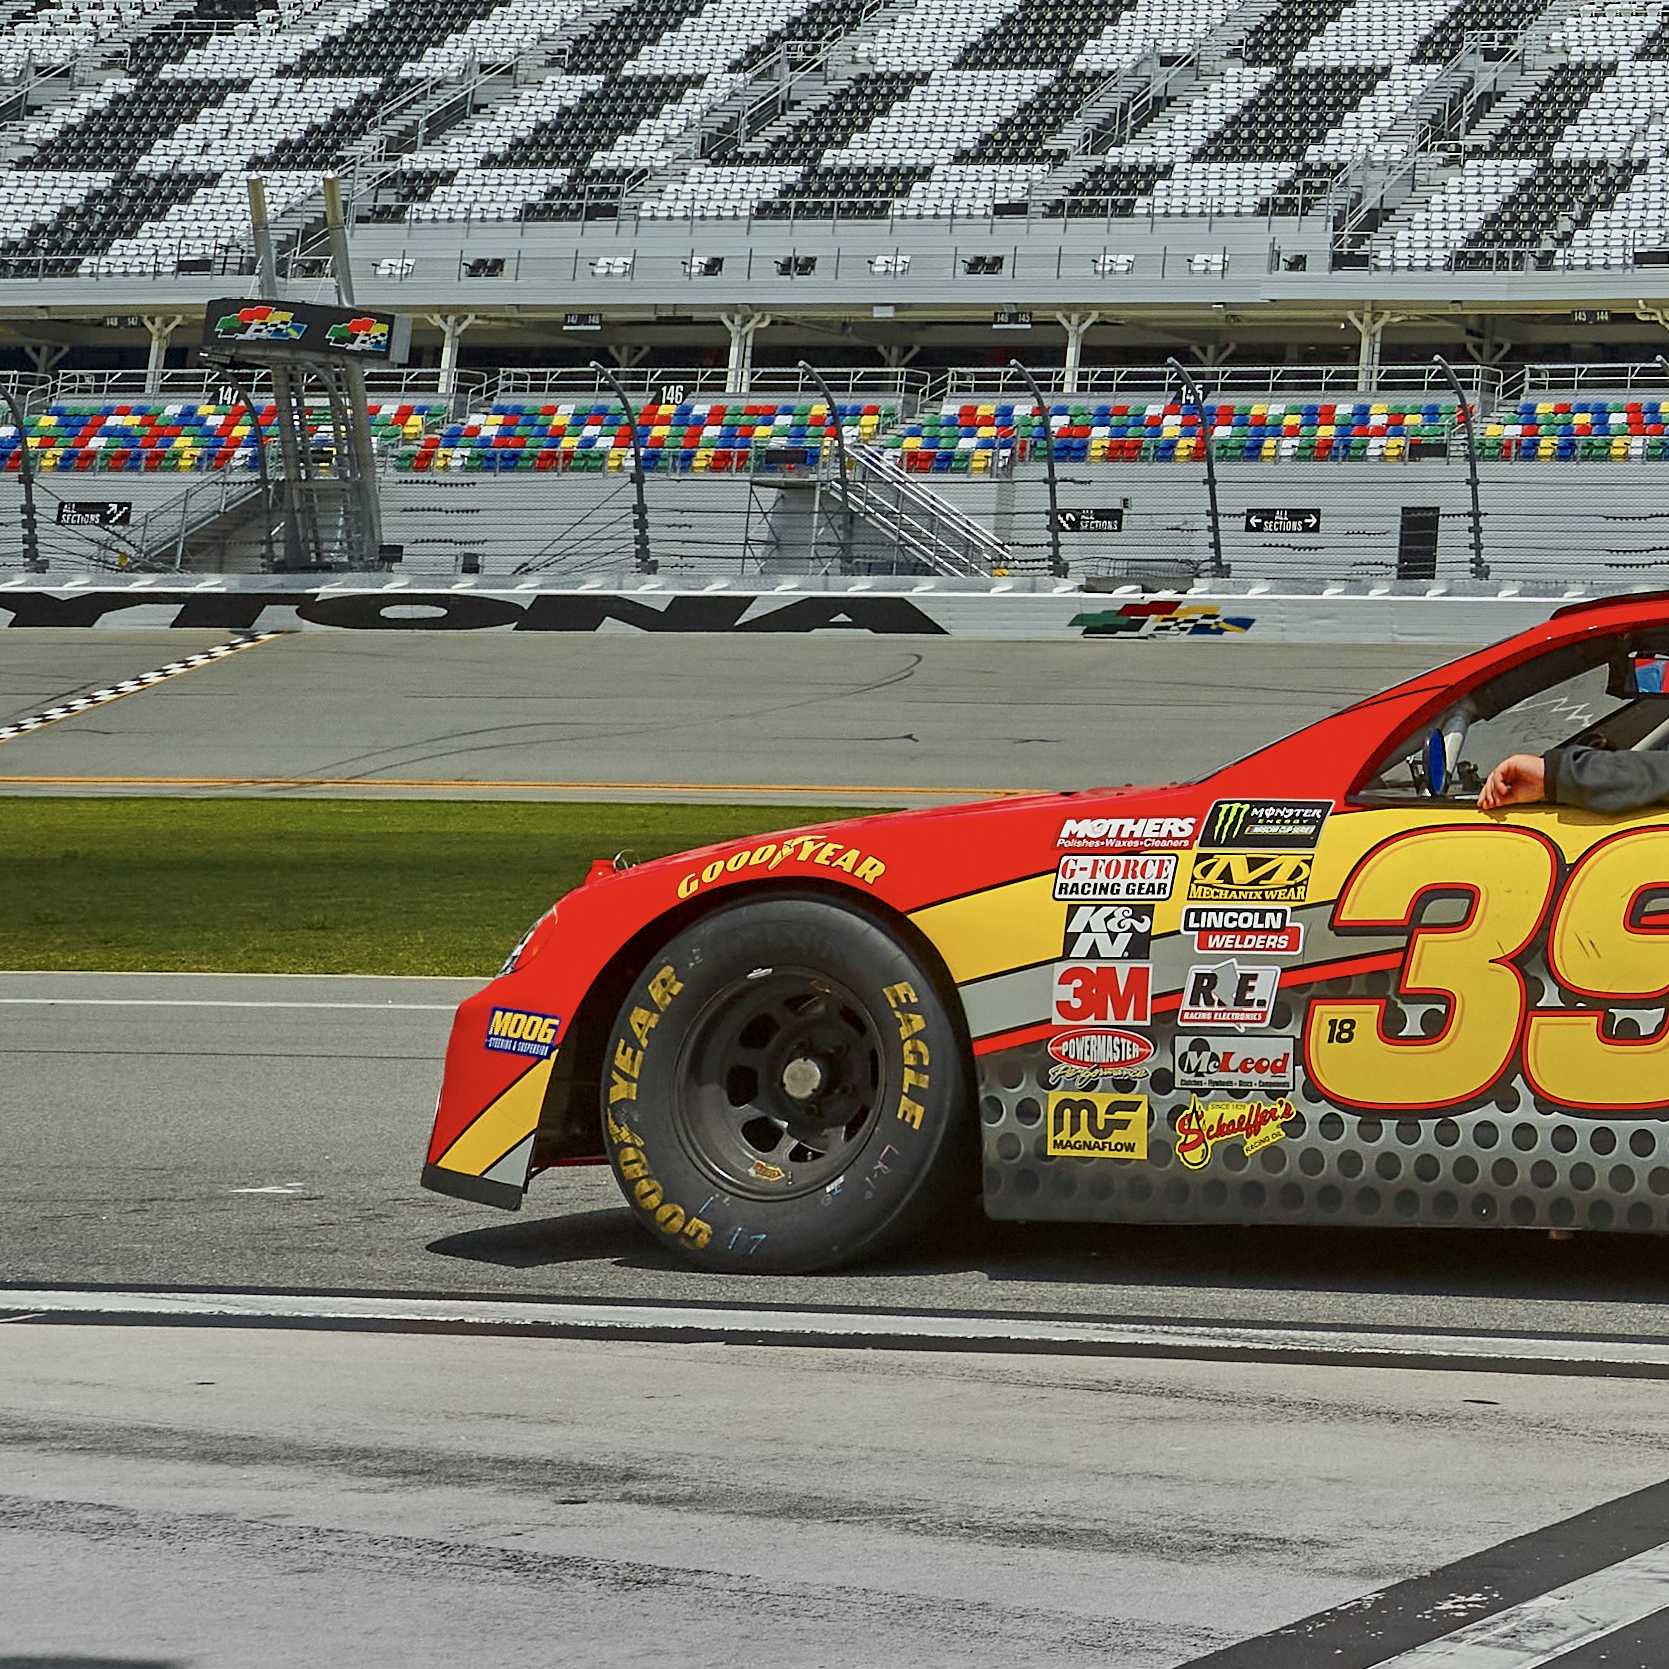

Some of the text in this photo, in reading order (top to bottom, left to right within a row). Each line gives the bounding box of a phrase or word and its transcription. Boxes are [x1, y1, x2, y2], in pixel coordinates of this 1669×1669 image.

[661, 385, 684, 404] 146
[62, 503, 77, 513] ALL
[1080, 510, 1095, 520] ALL
[1274, 510, 1289, 521] ALL
[60, 513, 101, 524] SECTIONS
[1079, 520, 1118, 531] SECTIONS
[1263, 520, 1303, 532] SECTIONS
[1250, 806, 1323, 819] MONSTER
[1060, 817, 1197, 839] MOTHERS
[676, 835, 886, 899] GOODYEAR
[1061, 857, 1174, 880] G-FORCE
[1058, 882, 1168, 896] RACING GEAR
[1189, 882, 1306, 901] MECHANIX WEAR
[1188, 910, 1283, 930] LINCOLN
[1207, 934, 1290, 949] WELDERS
[1056, 966, 1150, 1022] 3M
[1183, 1010, 1263, 1021] RACING ELECTRONICS
[488, 1010, 560, 1044] MOOG
[1327, 1019, 1356, 1044] 18
[882, 981, 930, 1130] EAGLE
[1061, 1034, 1140, 1062] POWERMASTER
[1183, 1050, 1290, 1075] McLeod
[1049, 1065, 1150, 1088] Performance
[606, 964, 713, 1250] GOODYEAR
[1178, 1099, 1294, 1154] Schaeffer's
[1053, 1139, 1136, 1153] MAGNAFLOW
[1245, 1135, 1270, 1153] RACING
